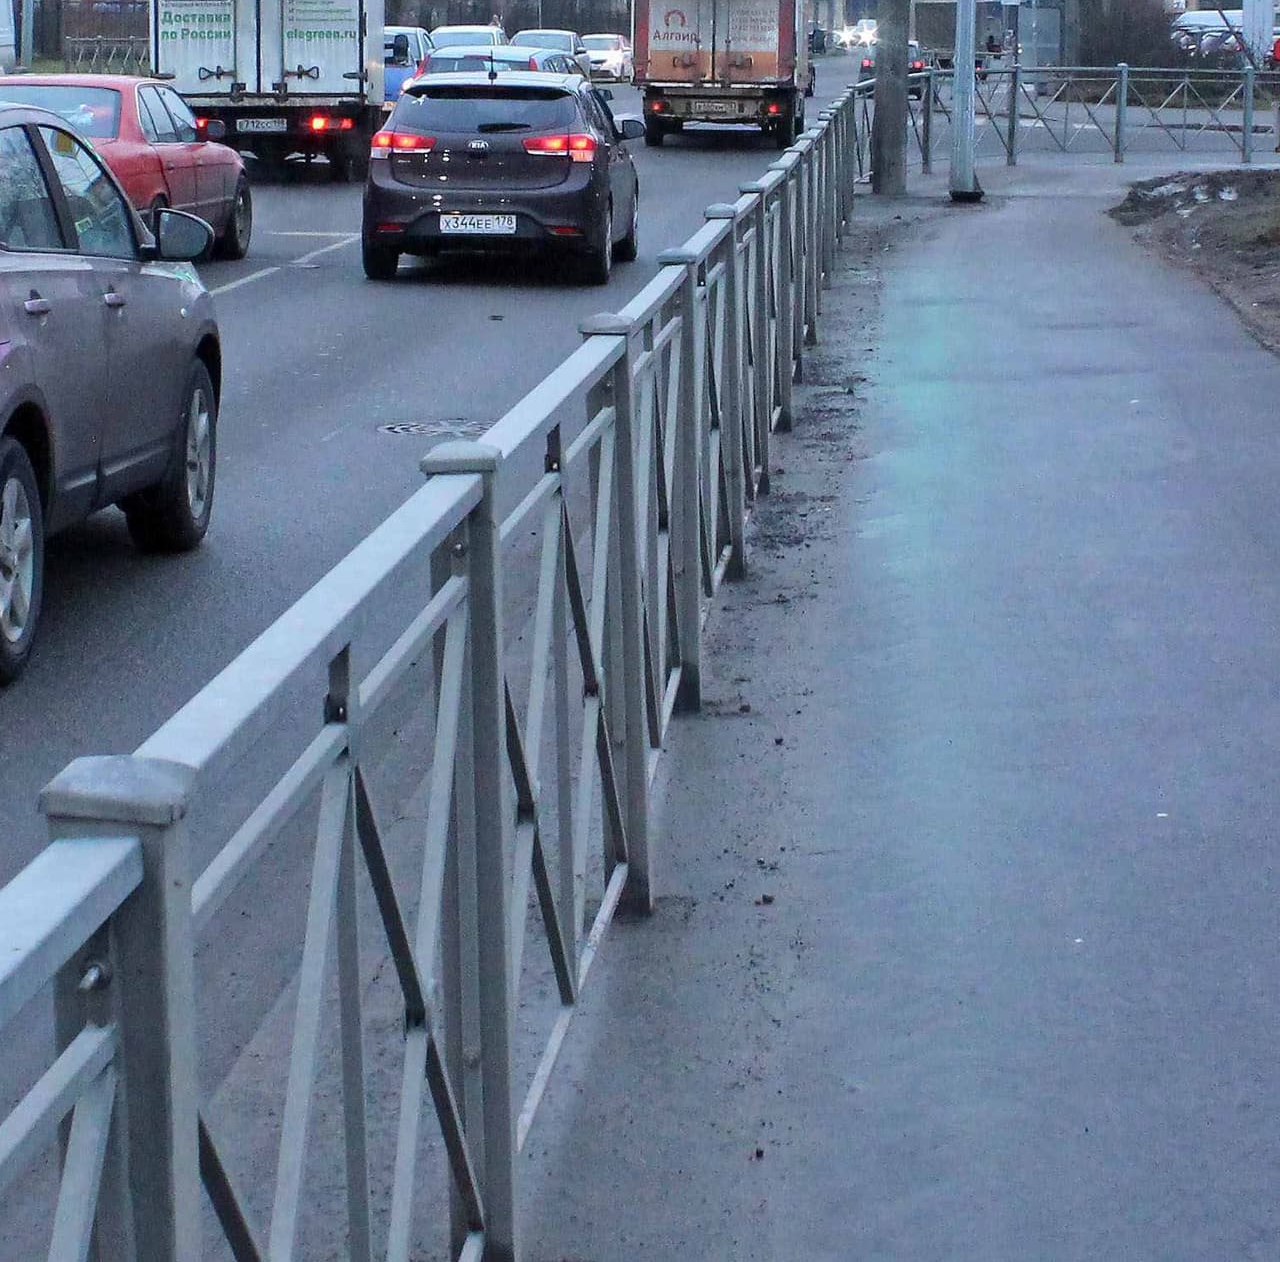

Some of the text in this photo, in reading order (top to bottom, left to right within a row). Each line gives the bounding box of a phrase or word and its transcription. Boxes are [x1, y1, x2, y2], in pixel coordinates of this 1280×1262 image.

[161, 11, 232, 25] Доставка
[161, 27, 232, 40] по России
[285, 28, 357, 42] elegreen.ru
